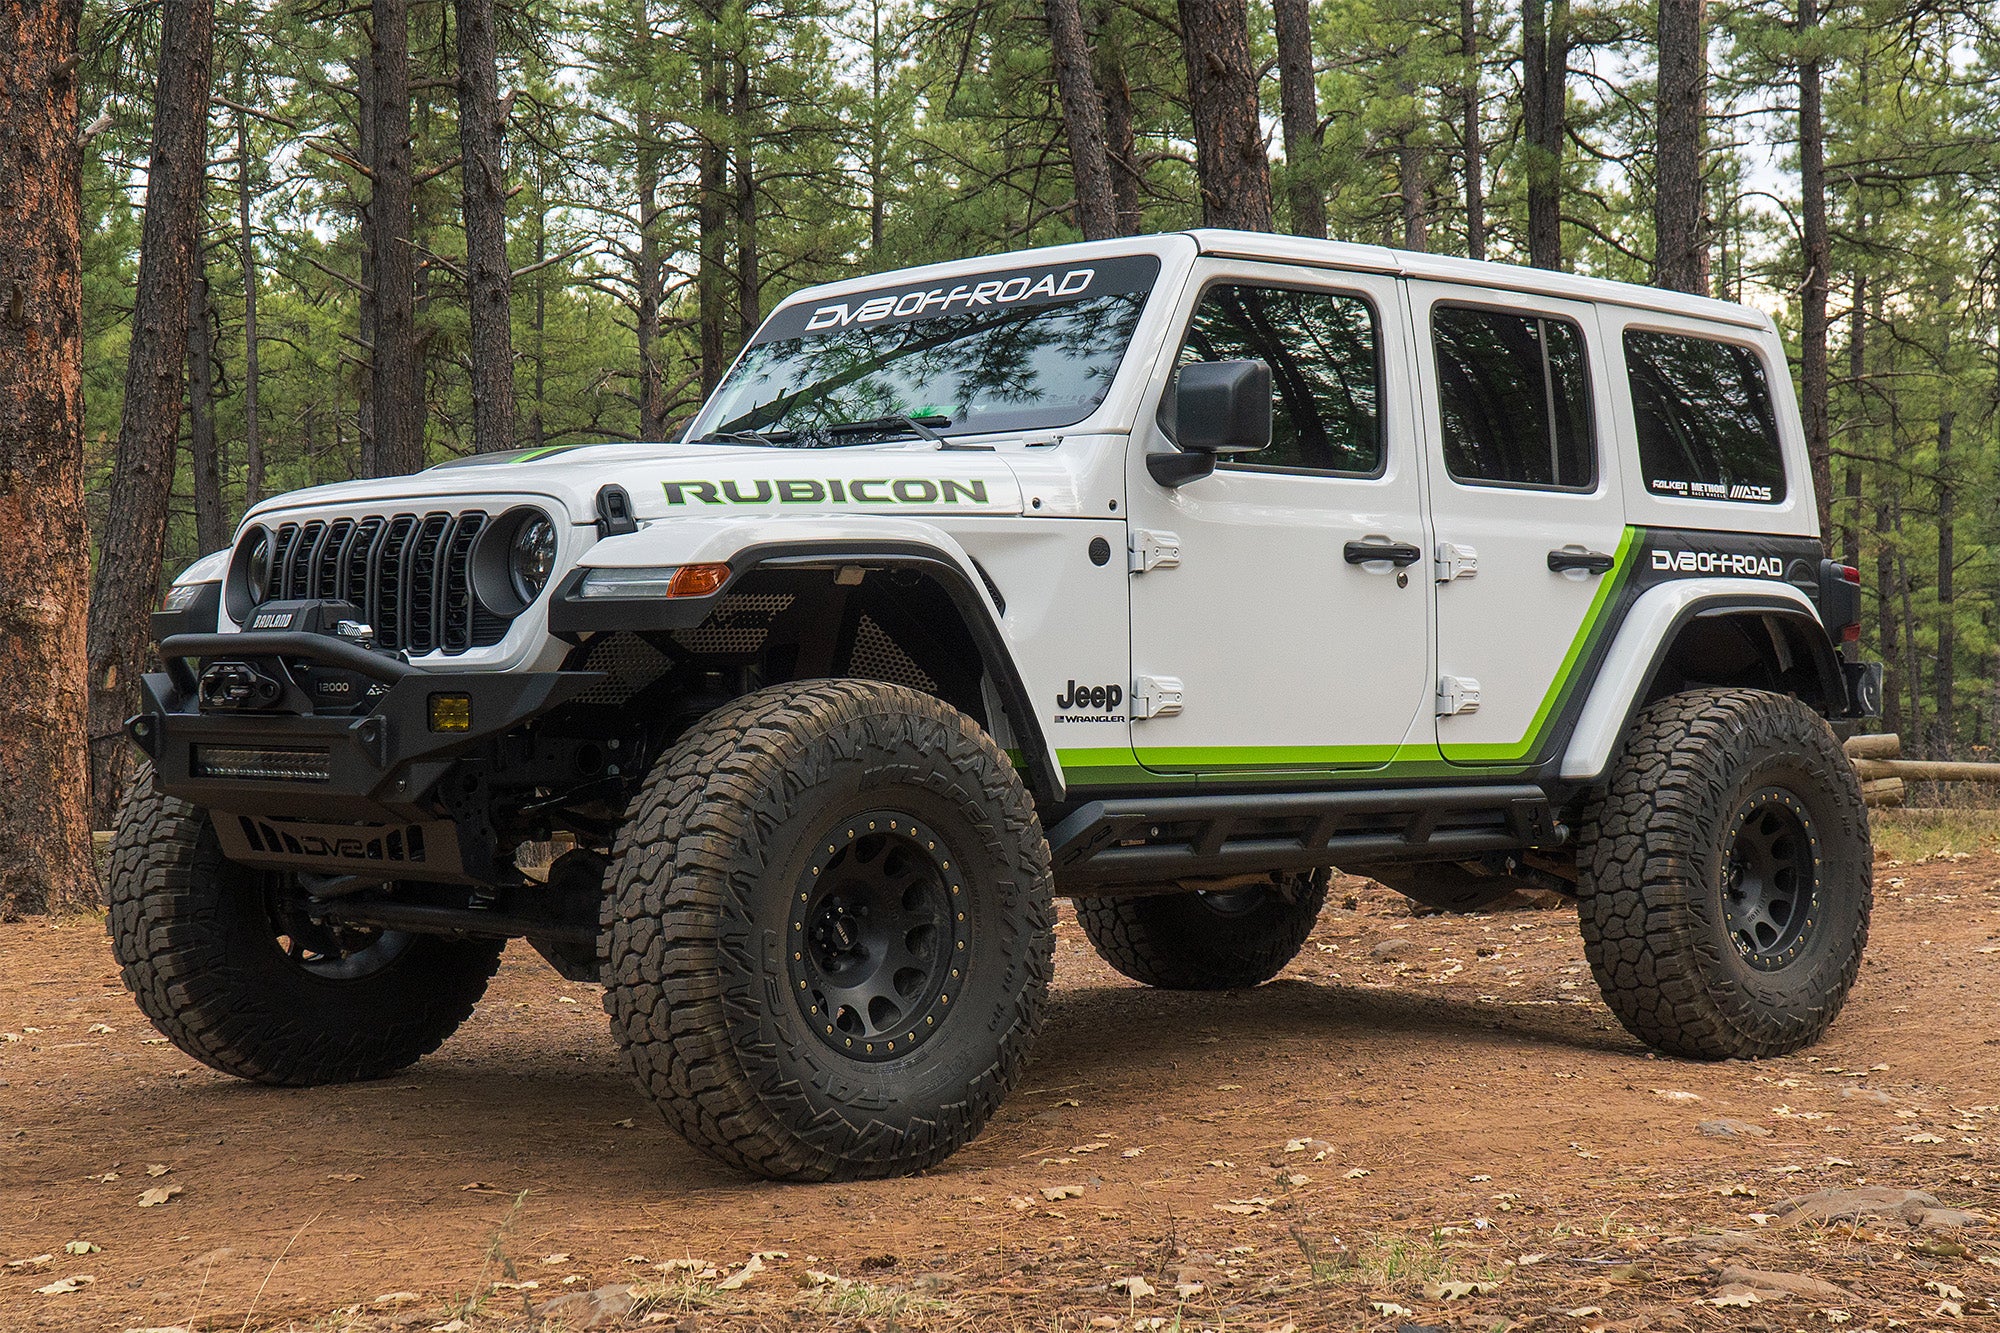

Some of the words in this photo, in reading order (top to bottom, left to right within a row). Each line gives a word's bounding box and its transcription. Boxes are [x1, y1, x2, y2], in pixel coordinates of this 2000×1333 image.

[1652, 479, 1688, 490] FALKEN
[1691, 482, 1726, 494] METHOD
[661, 479, 990, 505] RUBICON
[252, 614, 293, 629] BADLAND
[318, 682, 350, 692] 12000
[1056, 680, 1123, 712] Jeep
[1064, 715, 1126, 724] WRANGLER
[761, 927, 906, 1113] FALKEN
